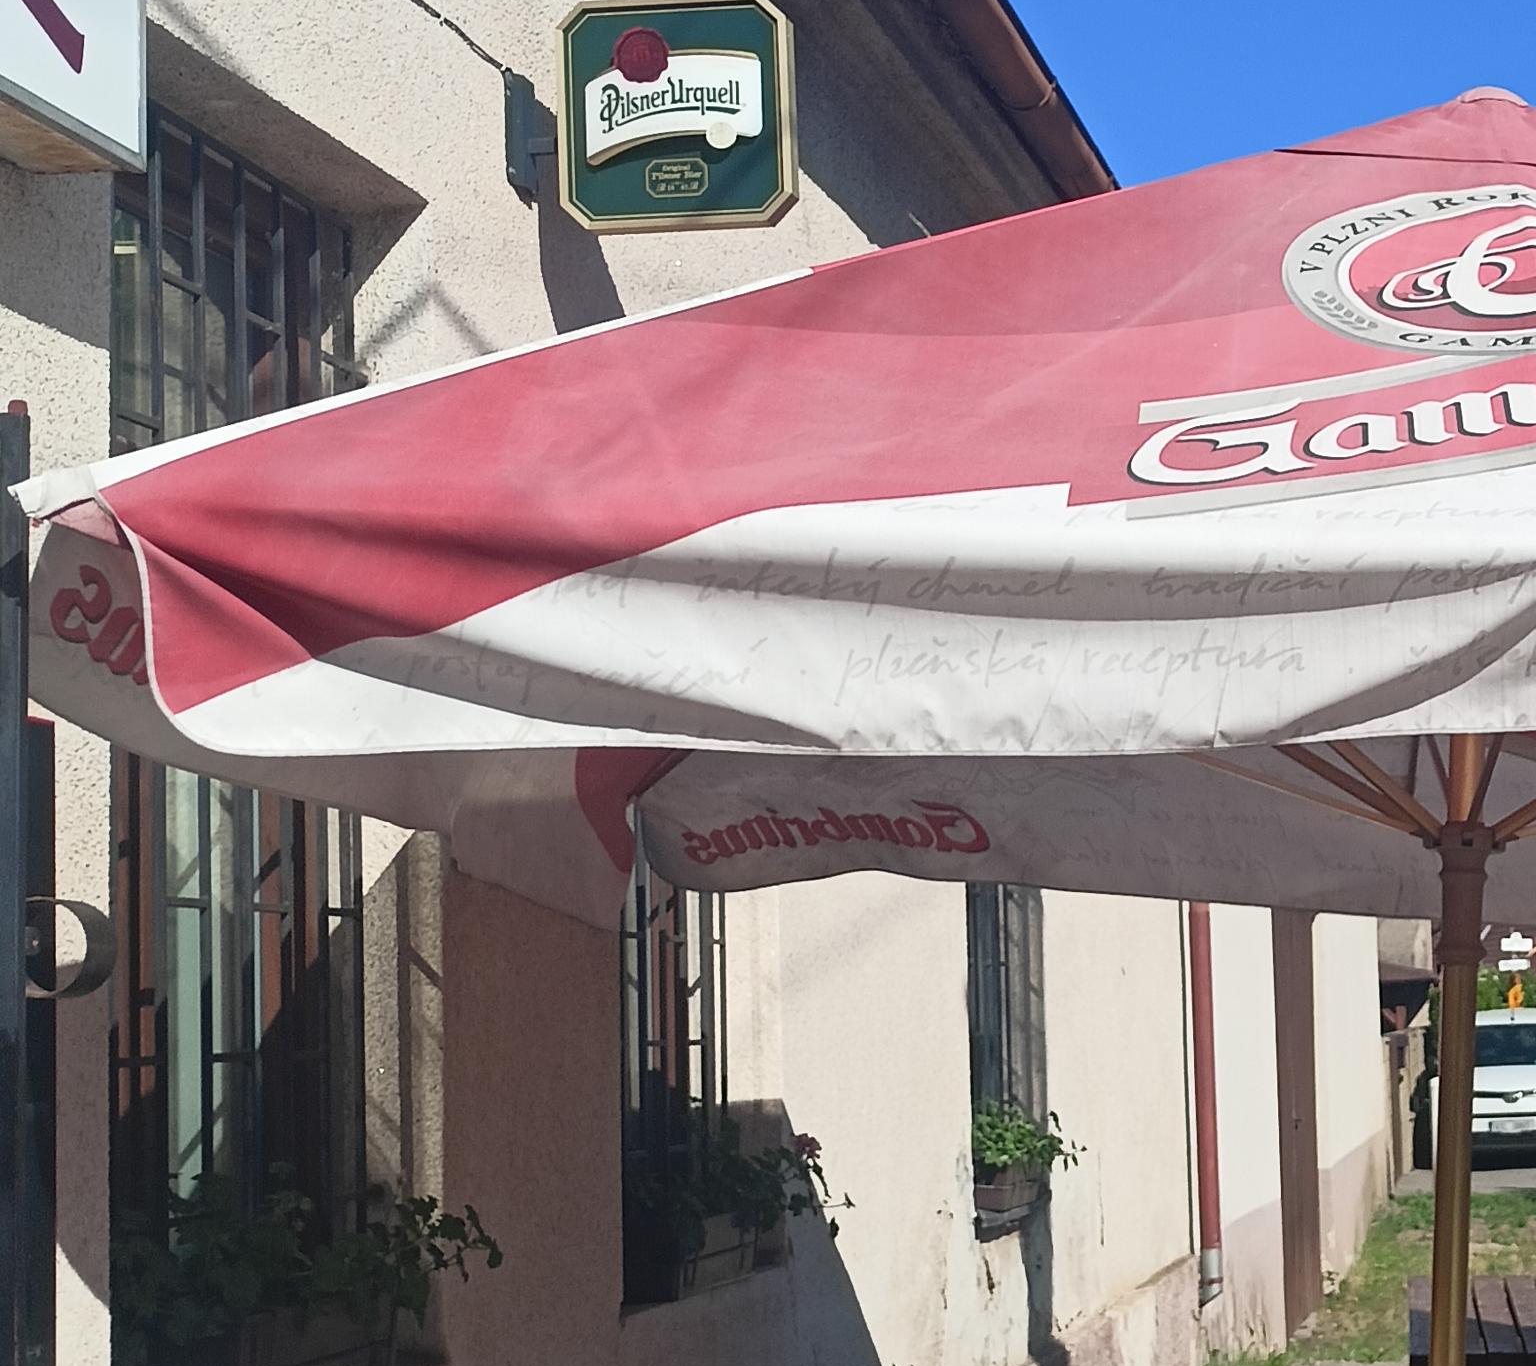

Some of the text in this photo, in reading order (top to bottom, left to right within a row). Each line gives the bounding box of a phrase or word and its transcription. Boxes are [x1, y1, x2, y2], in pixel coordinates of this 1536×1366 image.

[600, 76, 741, 134] Pilsner Urquell
[1300, 261, 1323, 275] V
